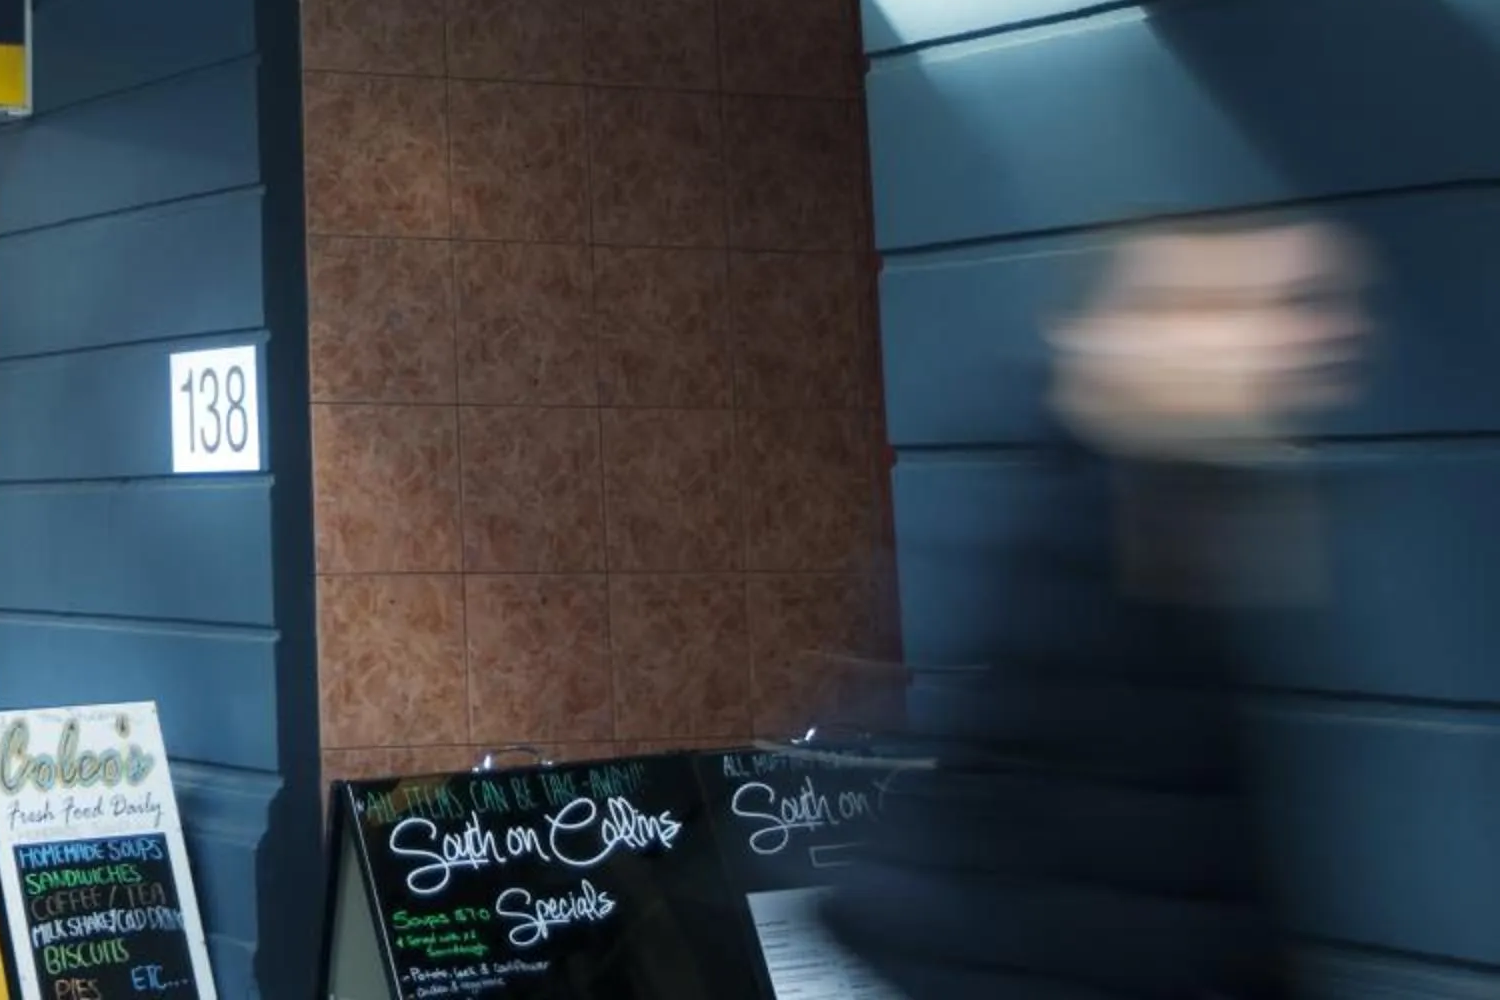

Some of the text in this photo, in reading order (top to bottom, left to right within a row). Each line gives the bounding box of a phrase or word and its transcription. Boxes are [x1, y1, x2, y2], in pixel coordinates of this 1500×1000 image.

[180, 365, 248, 454] 138
[8, 791, 164, 831] Fresh Food Daily
[731, 775, 840, 854] South
[19, 836, 164, 868] HOMEMADE SOUPS
[389, 796, 682, 894] South on Collins
[25, 862, 143, 895] SANDWICHES
[31, 885, 102, 920] COFFEE
[128, 882, 166, 905] TEA
[496, 878, 617, 946] Specials
[32, 916, 68, 948] MILK
[44, 938, 130, 975] BISCUITS
